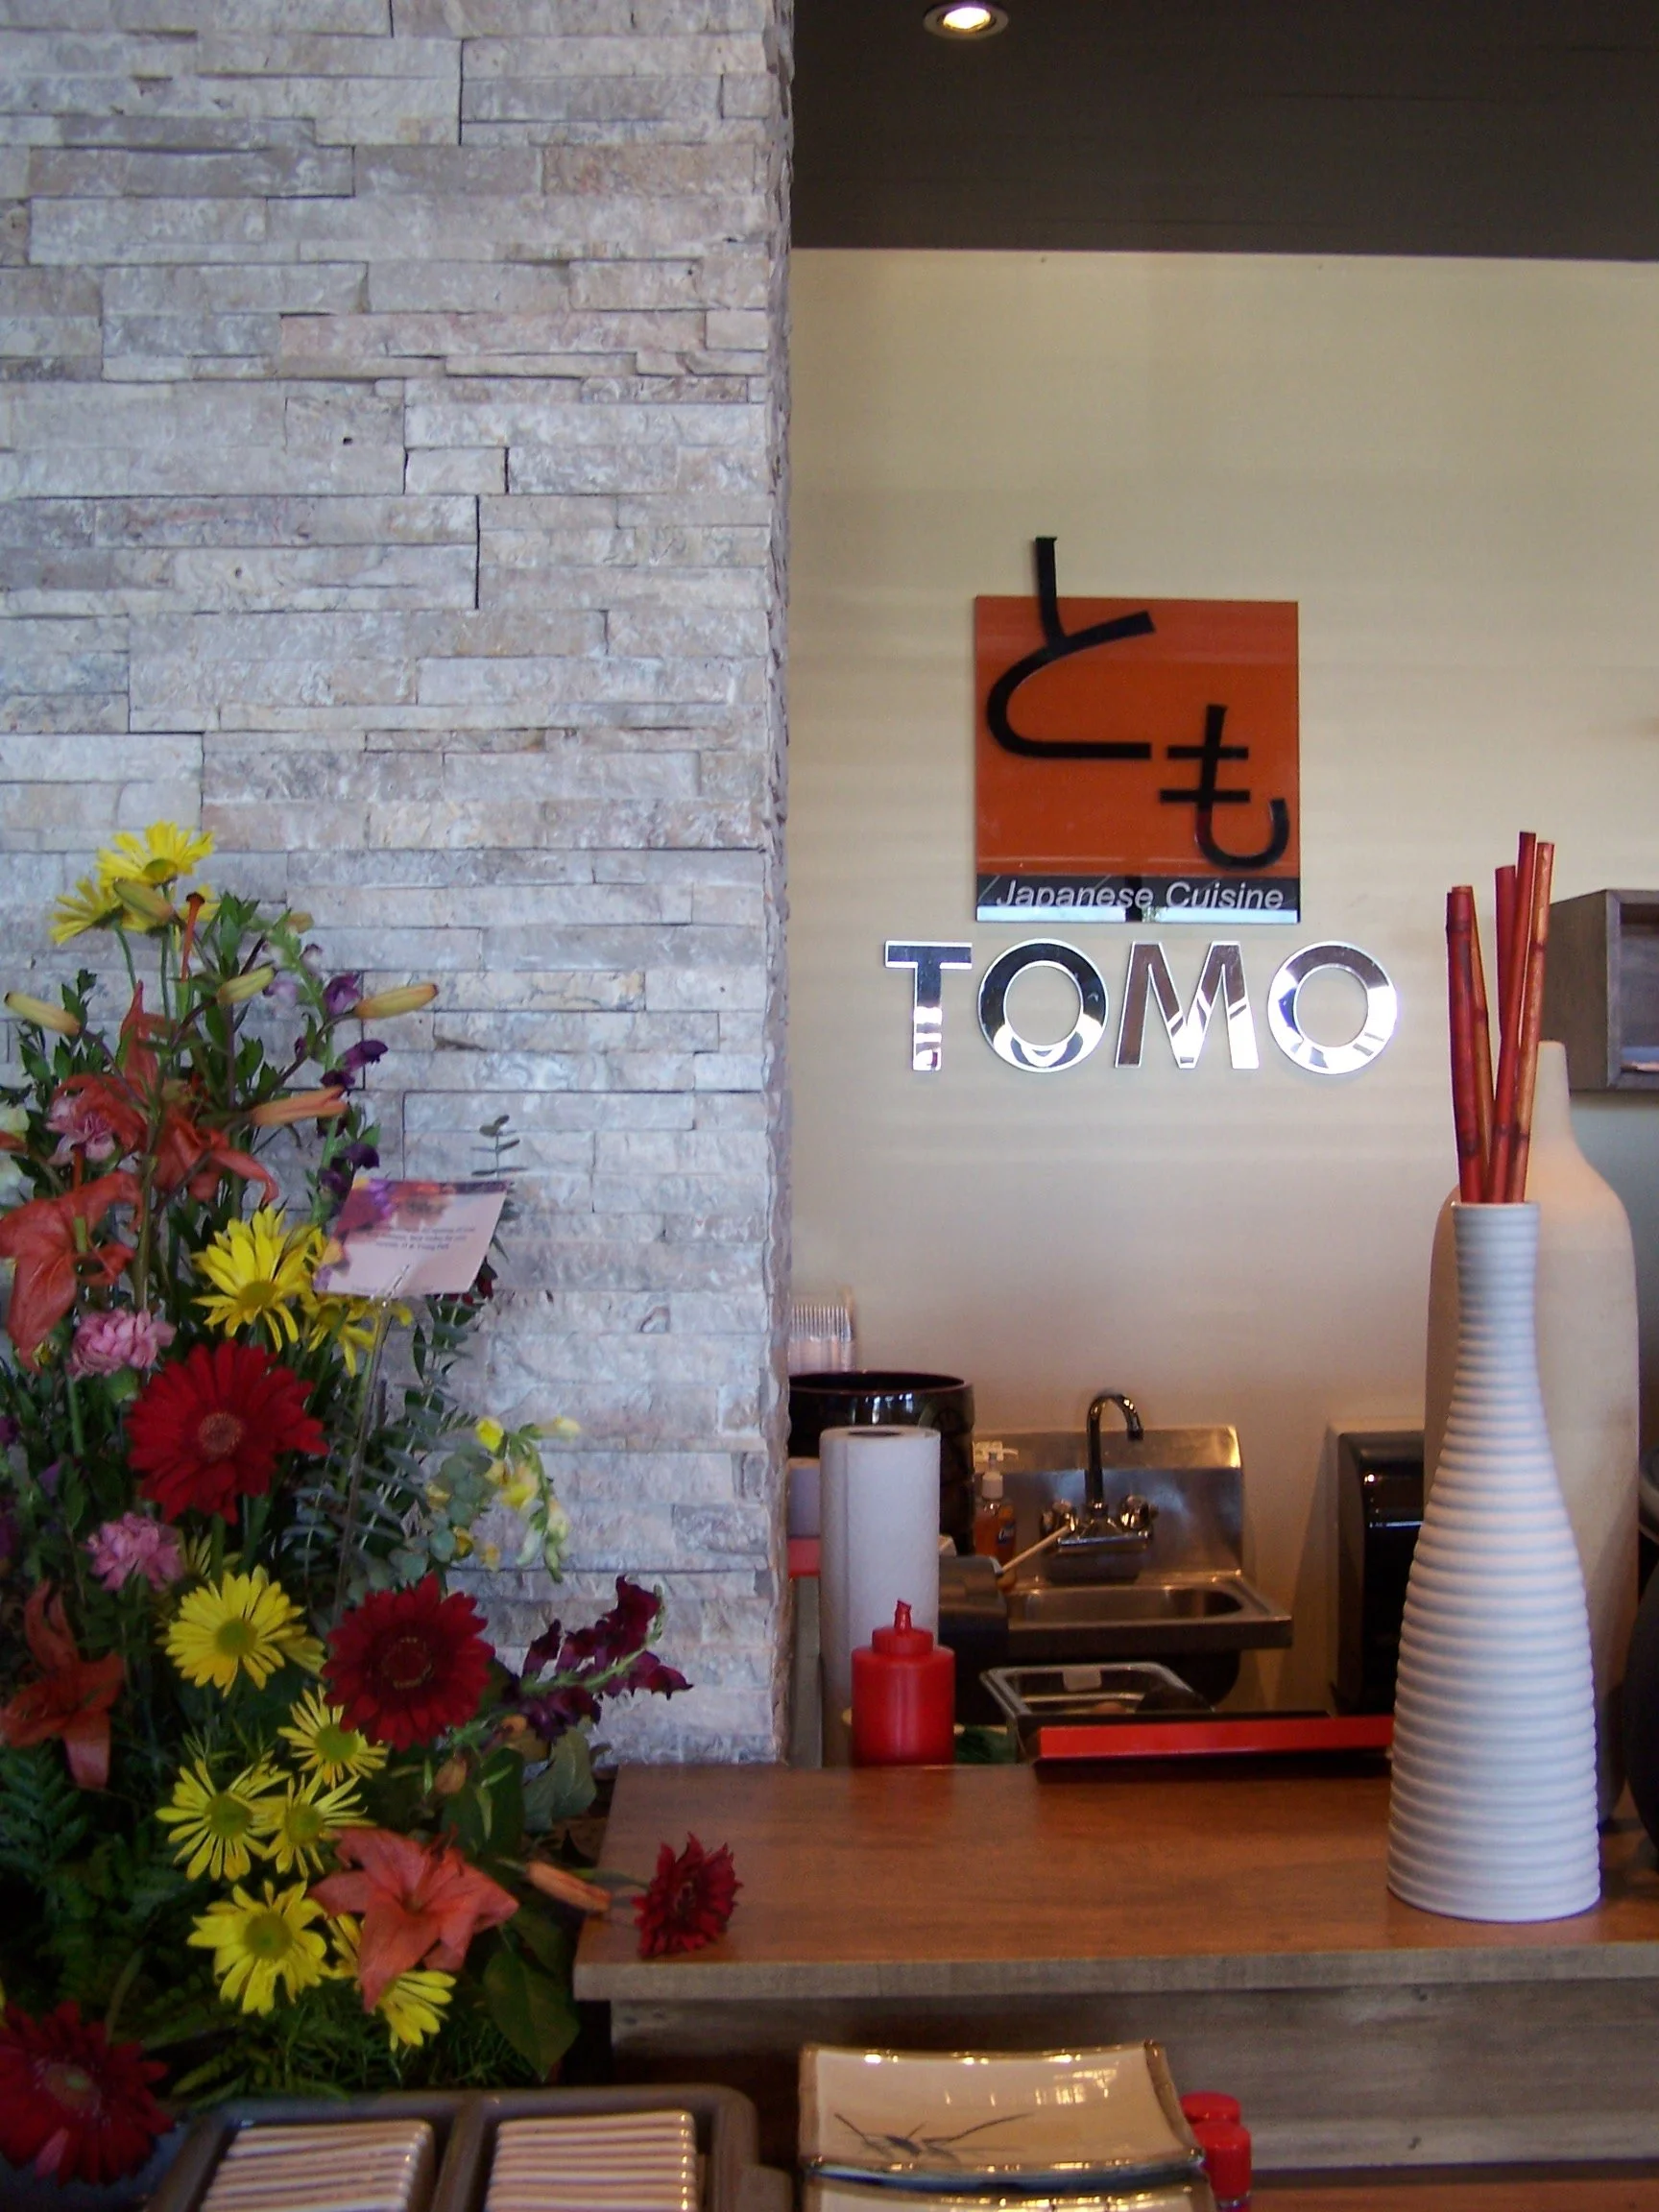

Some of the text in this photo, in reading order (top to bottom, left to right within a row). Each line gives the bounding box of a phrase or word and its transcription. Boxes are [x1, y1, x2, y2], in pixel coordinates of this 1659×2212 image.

[986, 536, 1290, 870] とも
[996, 879, 1285, 910] Japanese Cuisine
[884, 938, 1398, 1074] TOMO
